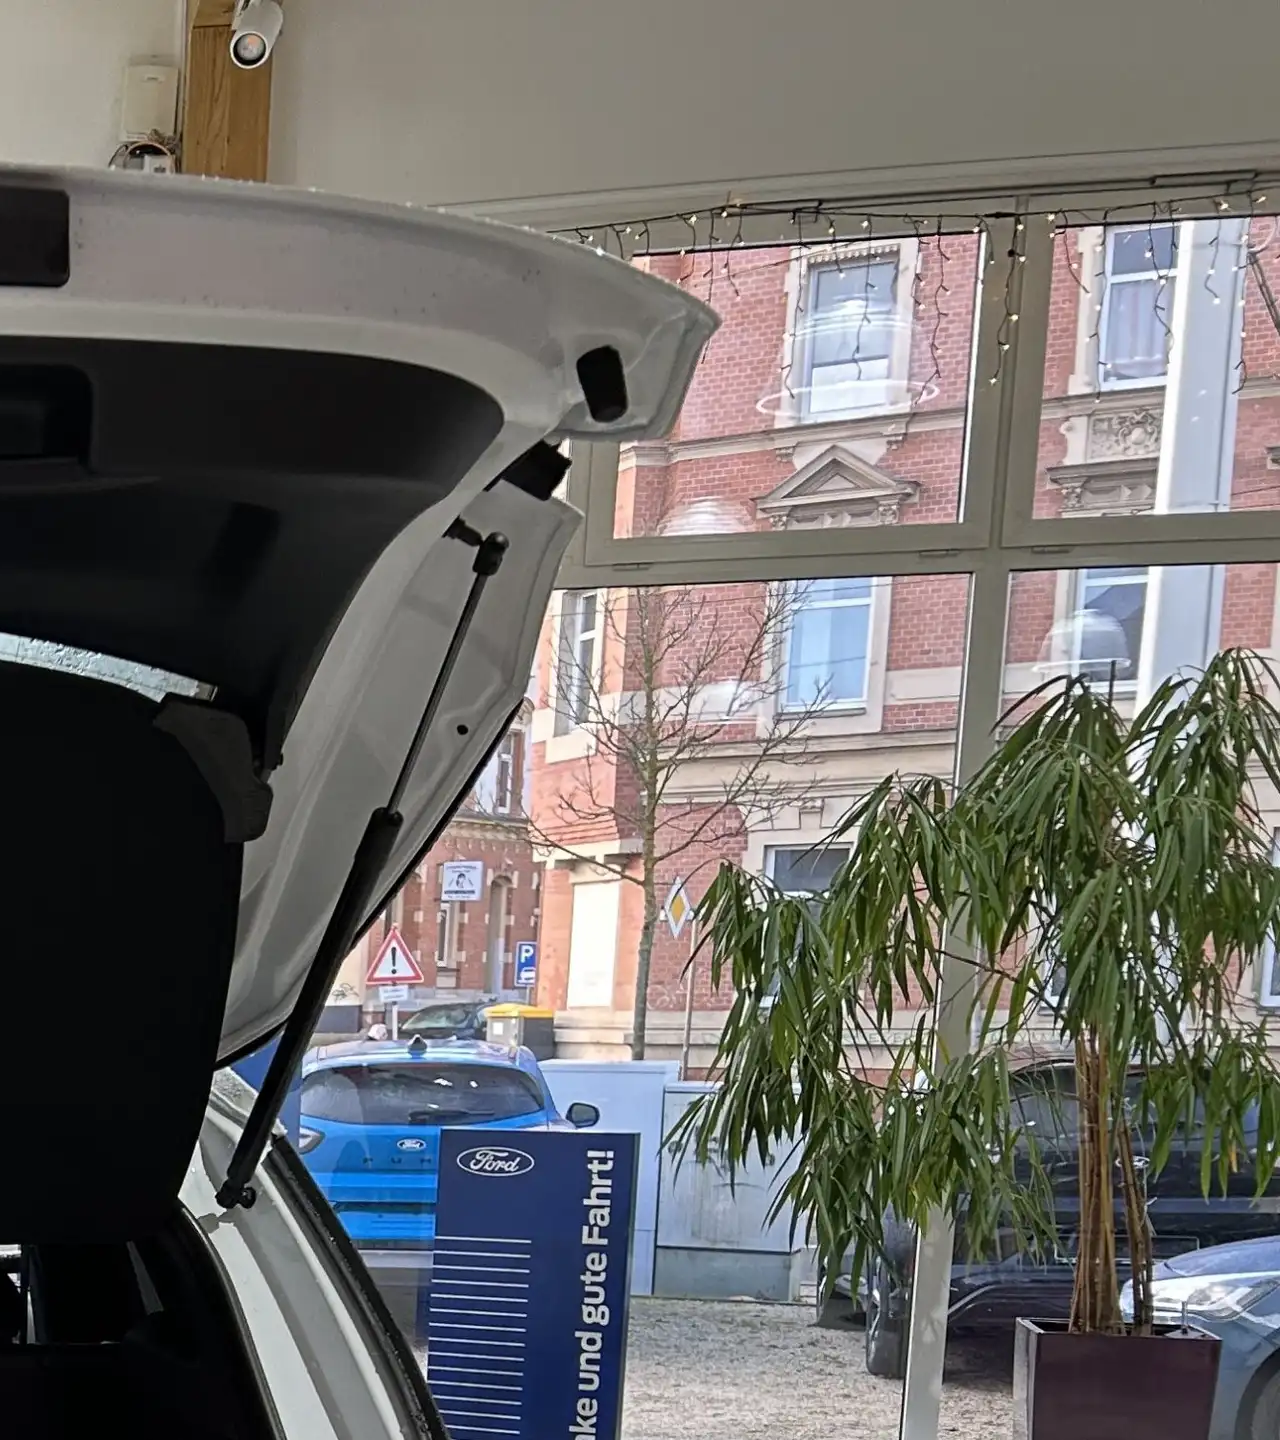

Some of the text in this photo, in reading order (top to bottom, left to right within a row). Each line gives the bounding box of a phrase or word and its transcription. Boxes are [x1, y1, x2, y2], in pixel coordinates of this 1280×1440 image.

[520, 945, 534, 963] P
[470, 1150, 521, 1172] Ford
[582, 1149, 615, 1246] Fahrt!
[579, 1252, 610, 1327] gute
[574, 1331, 603, 1391] und
